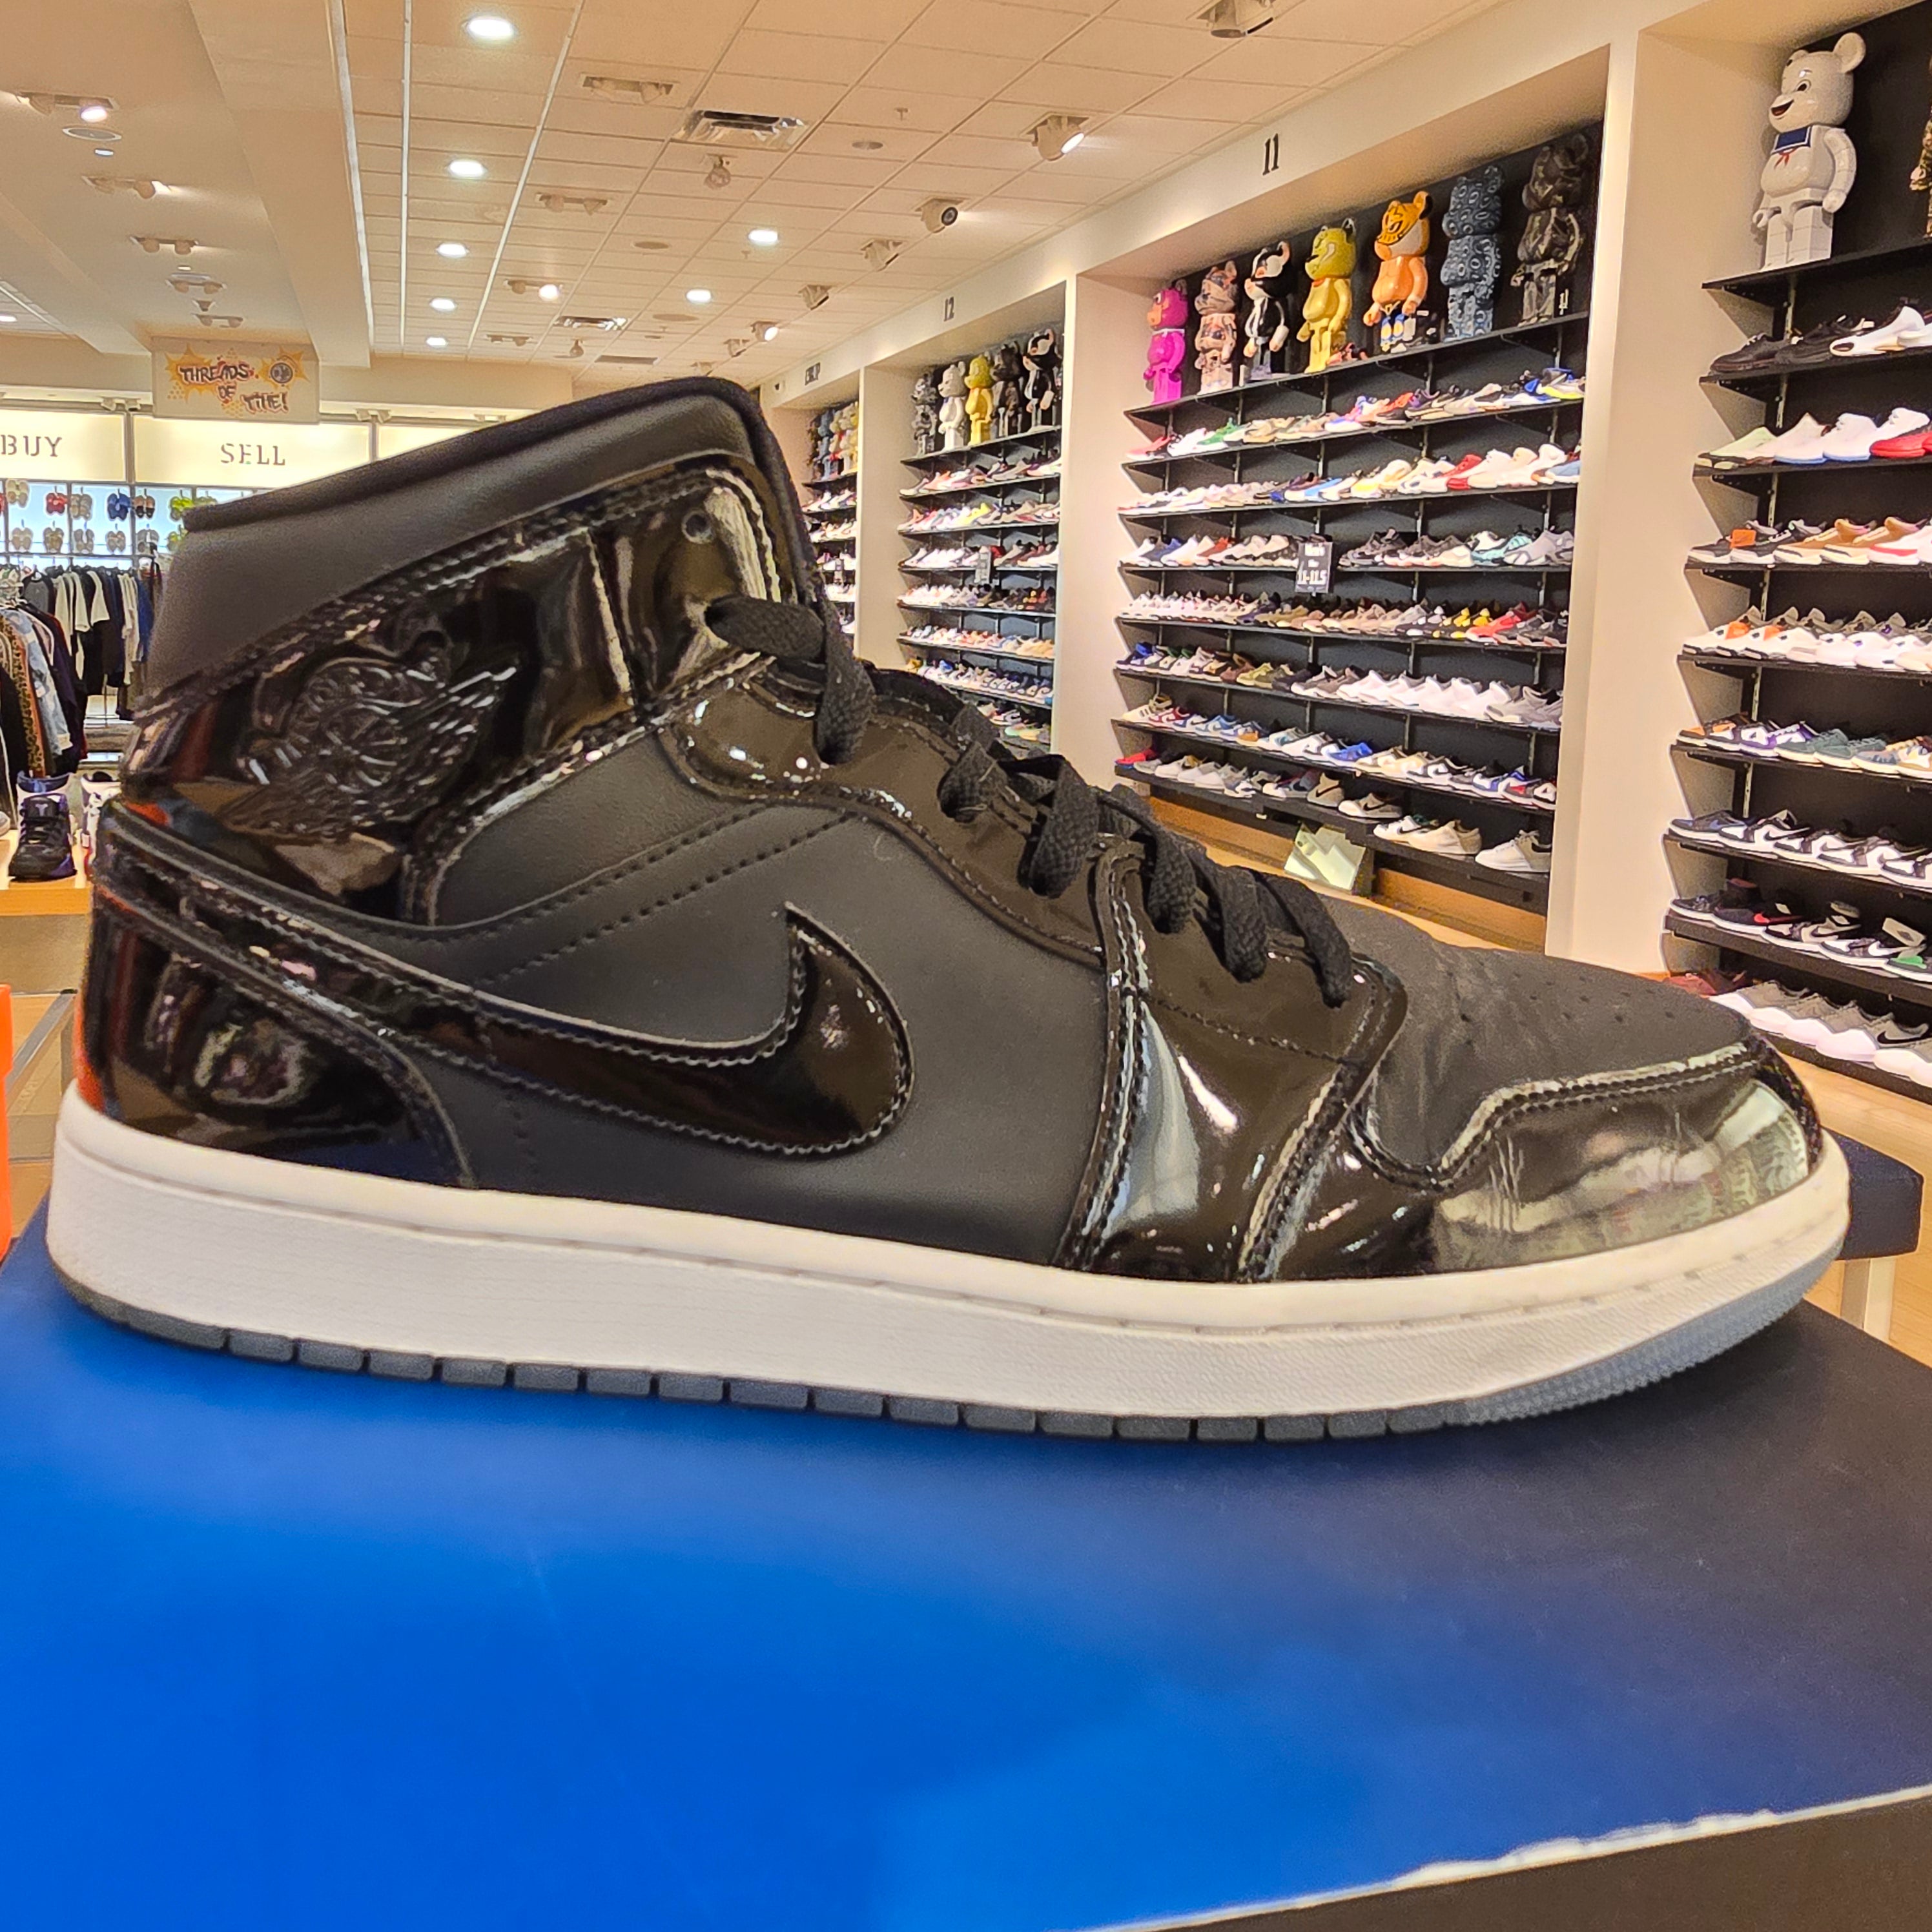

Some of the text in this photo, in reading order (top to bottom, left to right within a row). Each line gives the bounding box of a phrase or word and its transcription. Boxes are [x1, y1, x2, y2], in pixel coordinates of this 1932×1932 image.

[1262, 133, 1279, 176] 11
[943, 296, 954, 322] 12
[180, 363, 249, 382] THREADS
[218, 384, 236, 400] OF
[0, 435, 62, 457] BUY
[220, 443, 285, 465] SELL
